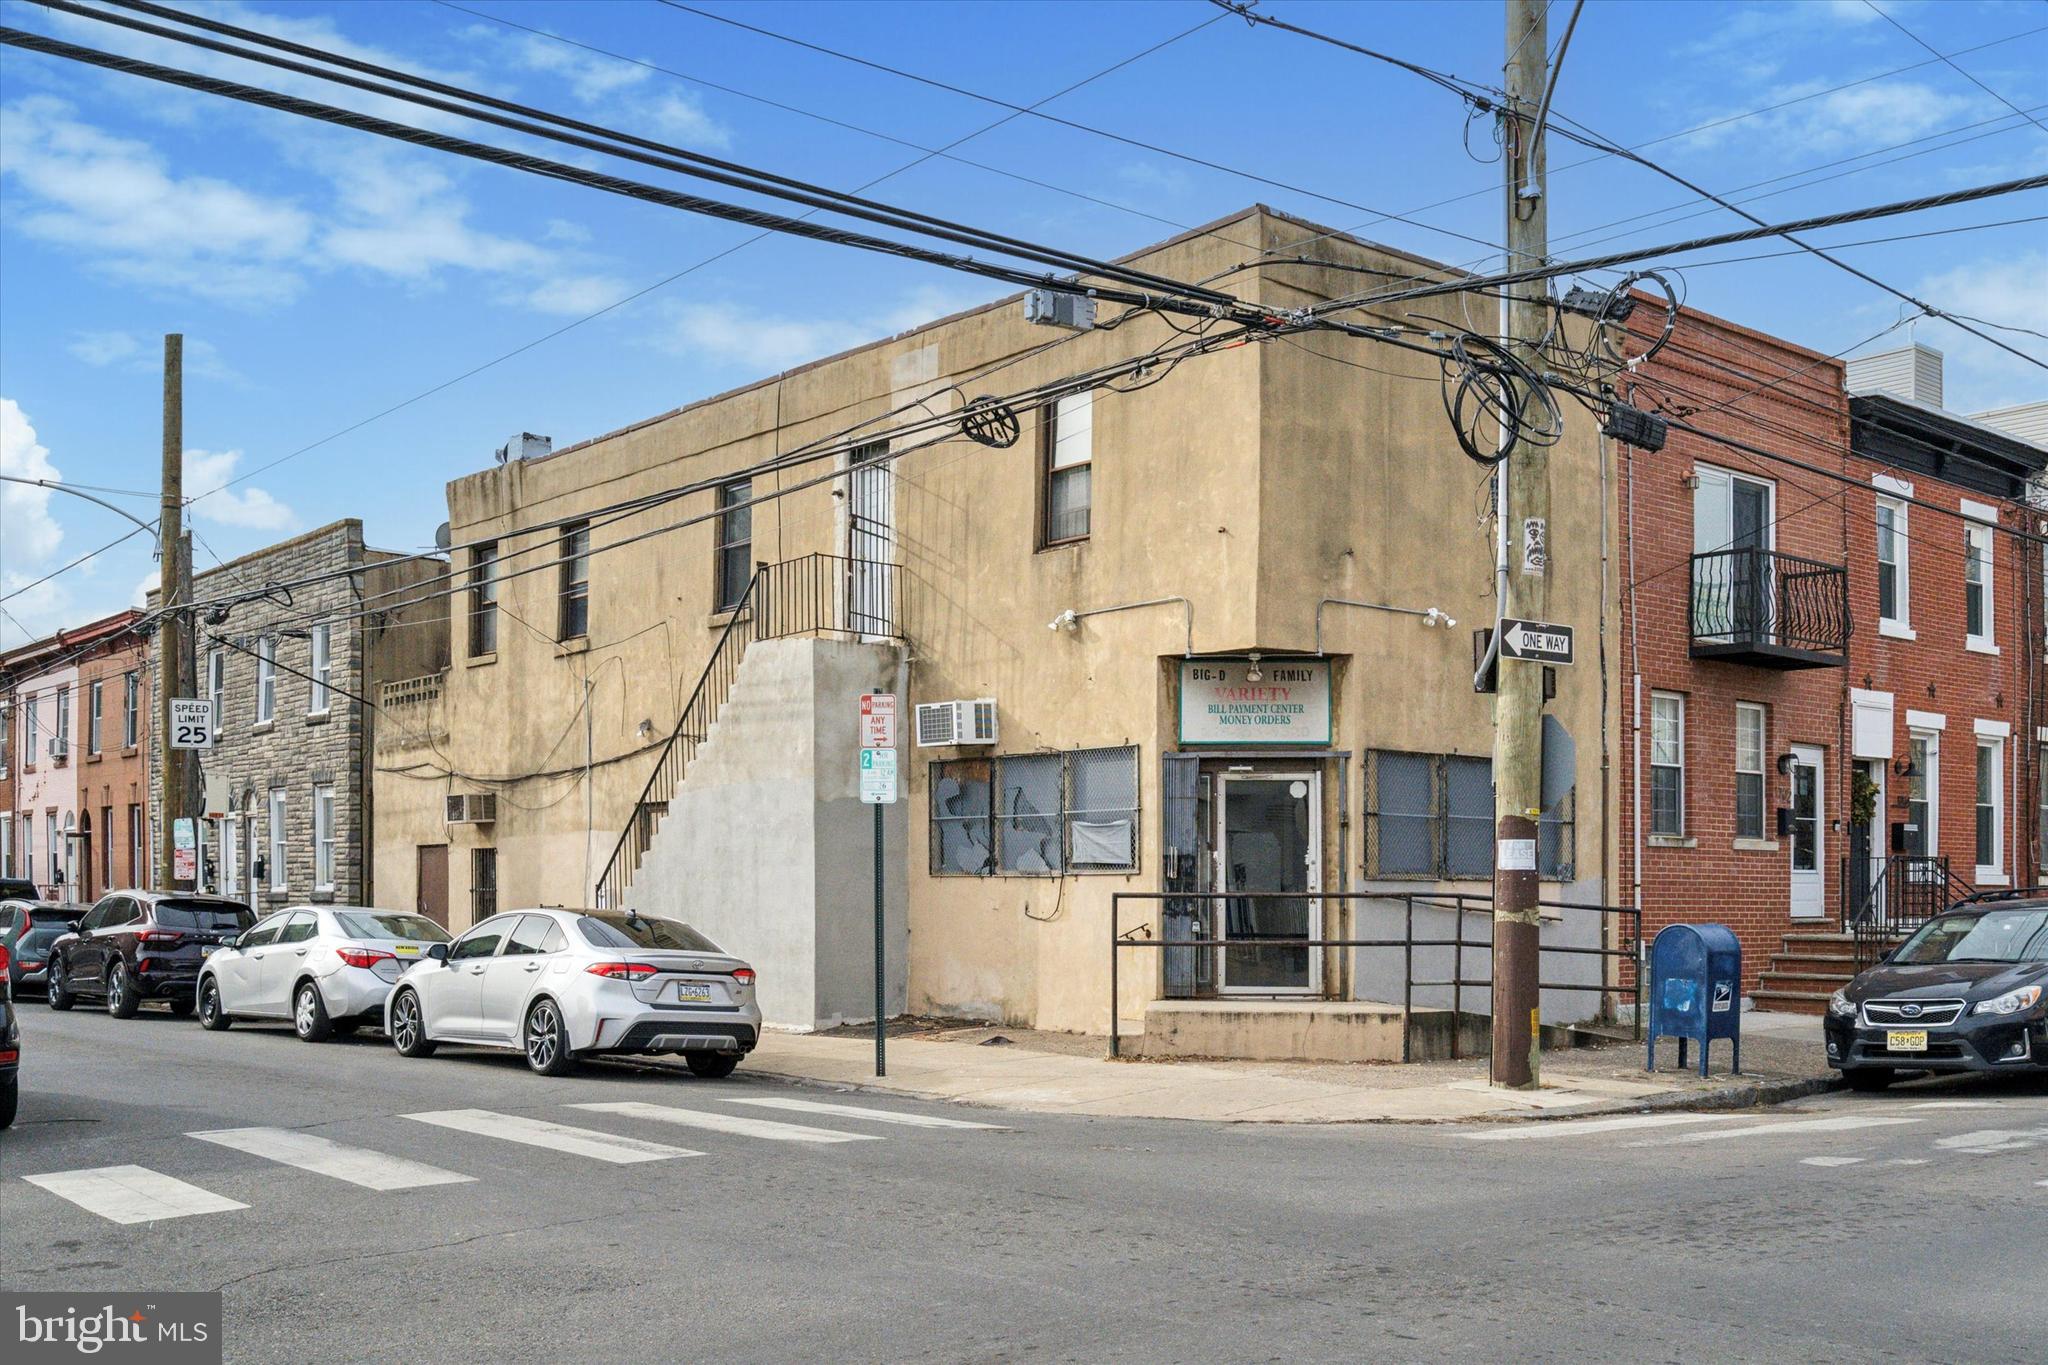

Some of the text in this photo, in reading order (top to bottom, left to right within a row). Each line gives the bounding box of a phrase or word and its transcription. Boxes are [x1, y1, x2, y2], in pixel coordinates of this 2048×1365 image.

[1522, 632, 1566, 652] ONE WAY
[1274, 670, 1313, 682] FAMILY
[1215, 687, 1292, 701] VARIETY
[175, 704, 209, 713] SPEED
[862, 700, 894, 710] NO PARKING
[1208, 704, 1305, 714] BILL PAYMENT CENTER
[178, 715, 205, 723] LIMIT
[871, 716, 885, 724] ANY
[1220, 715, 1291, 725] MONEY ORDERS
[177, 726, 207, 743] 25
[870, 726, 886, 735] TIME
[863, 752, 870, 767] 2
